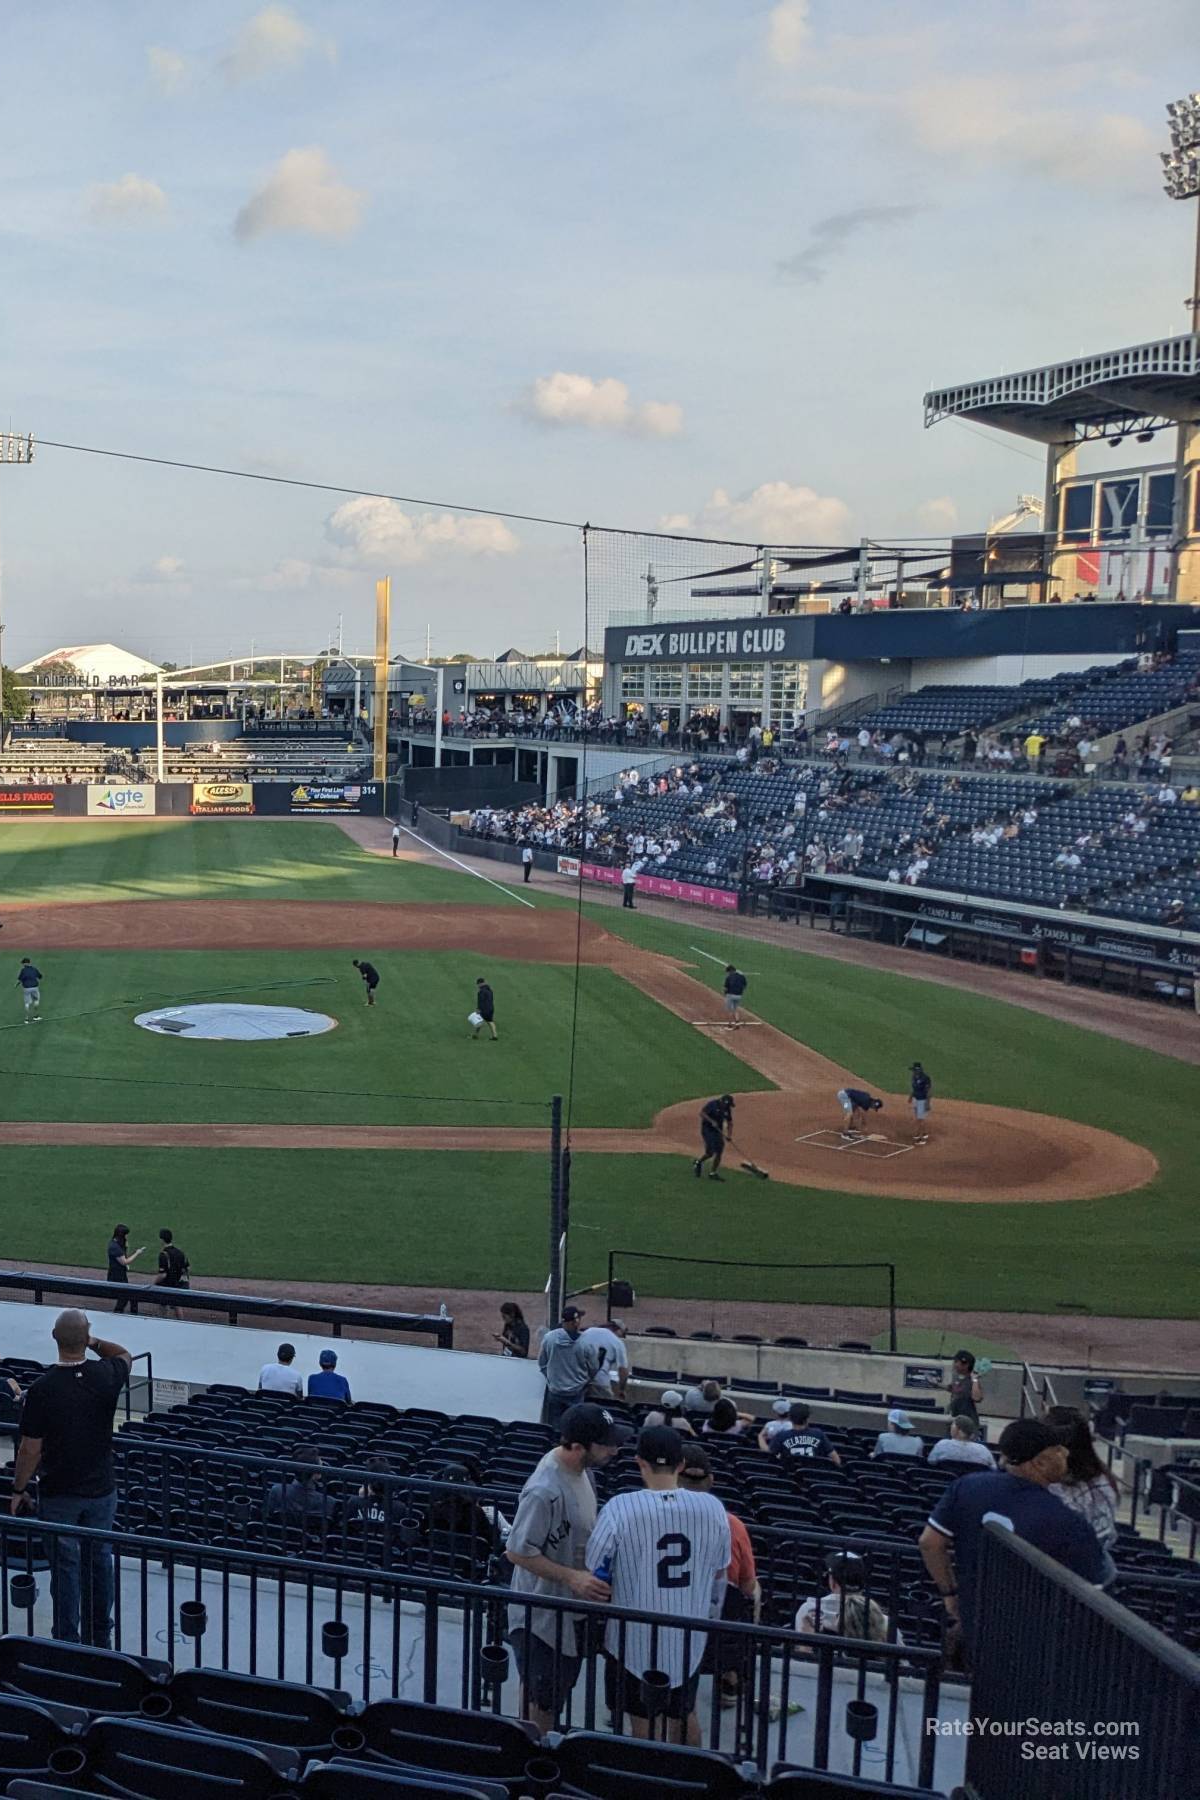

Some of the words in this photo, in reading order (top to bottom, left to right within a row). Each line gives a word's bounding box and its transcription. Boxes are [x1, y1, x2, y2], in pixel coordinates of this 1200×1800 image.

[625, 633, 667, 657] DEX
[669, 630, 737, 655] BULLPEN
[742, 628, 786, 653] CLUB
[43, 674, 100, 687] OUTFIELD
[108, 674, 139, 687] BAR
[22, 792, 54, 801] FARGO
[114, 789, 143, 806] gte
[209, 786, 236, 795] ALESSI
[362, 786, 376, 794] 314
[927, 906, 949, 918] TAMPA
[950, 911, 964, 921] BAY
[1042, 928, 1069, 941] TAMPA
[1069, 932, 1086, 944] BAY
[783, 1435, 821, 1449] VELAZQUEZ
[547, 1519, 571, 1551] NEW
[656, 1532, 692, 1589] 2
